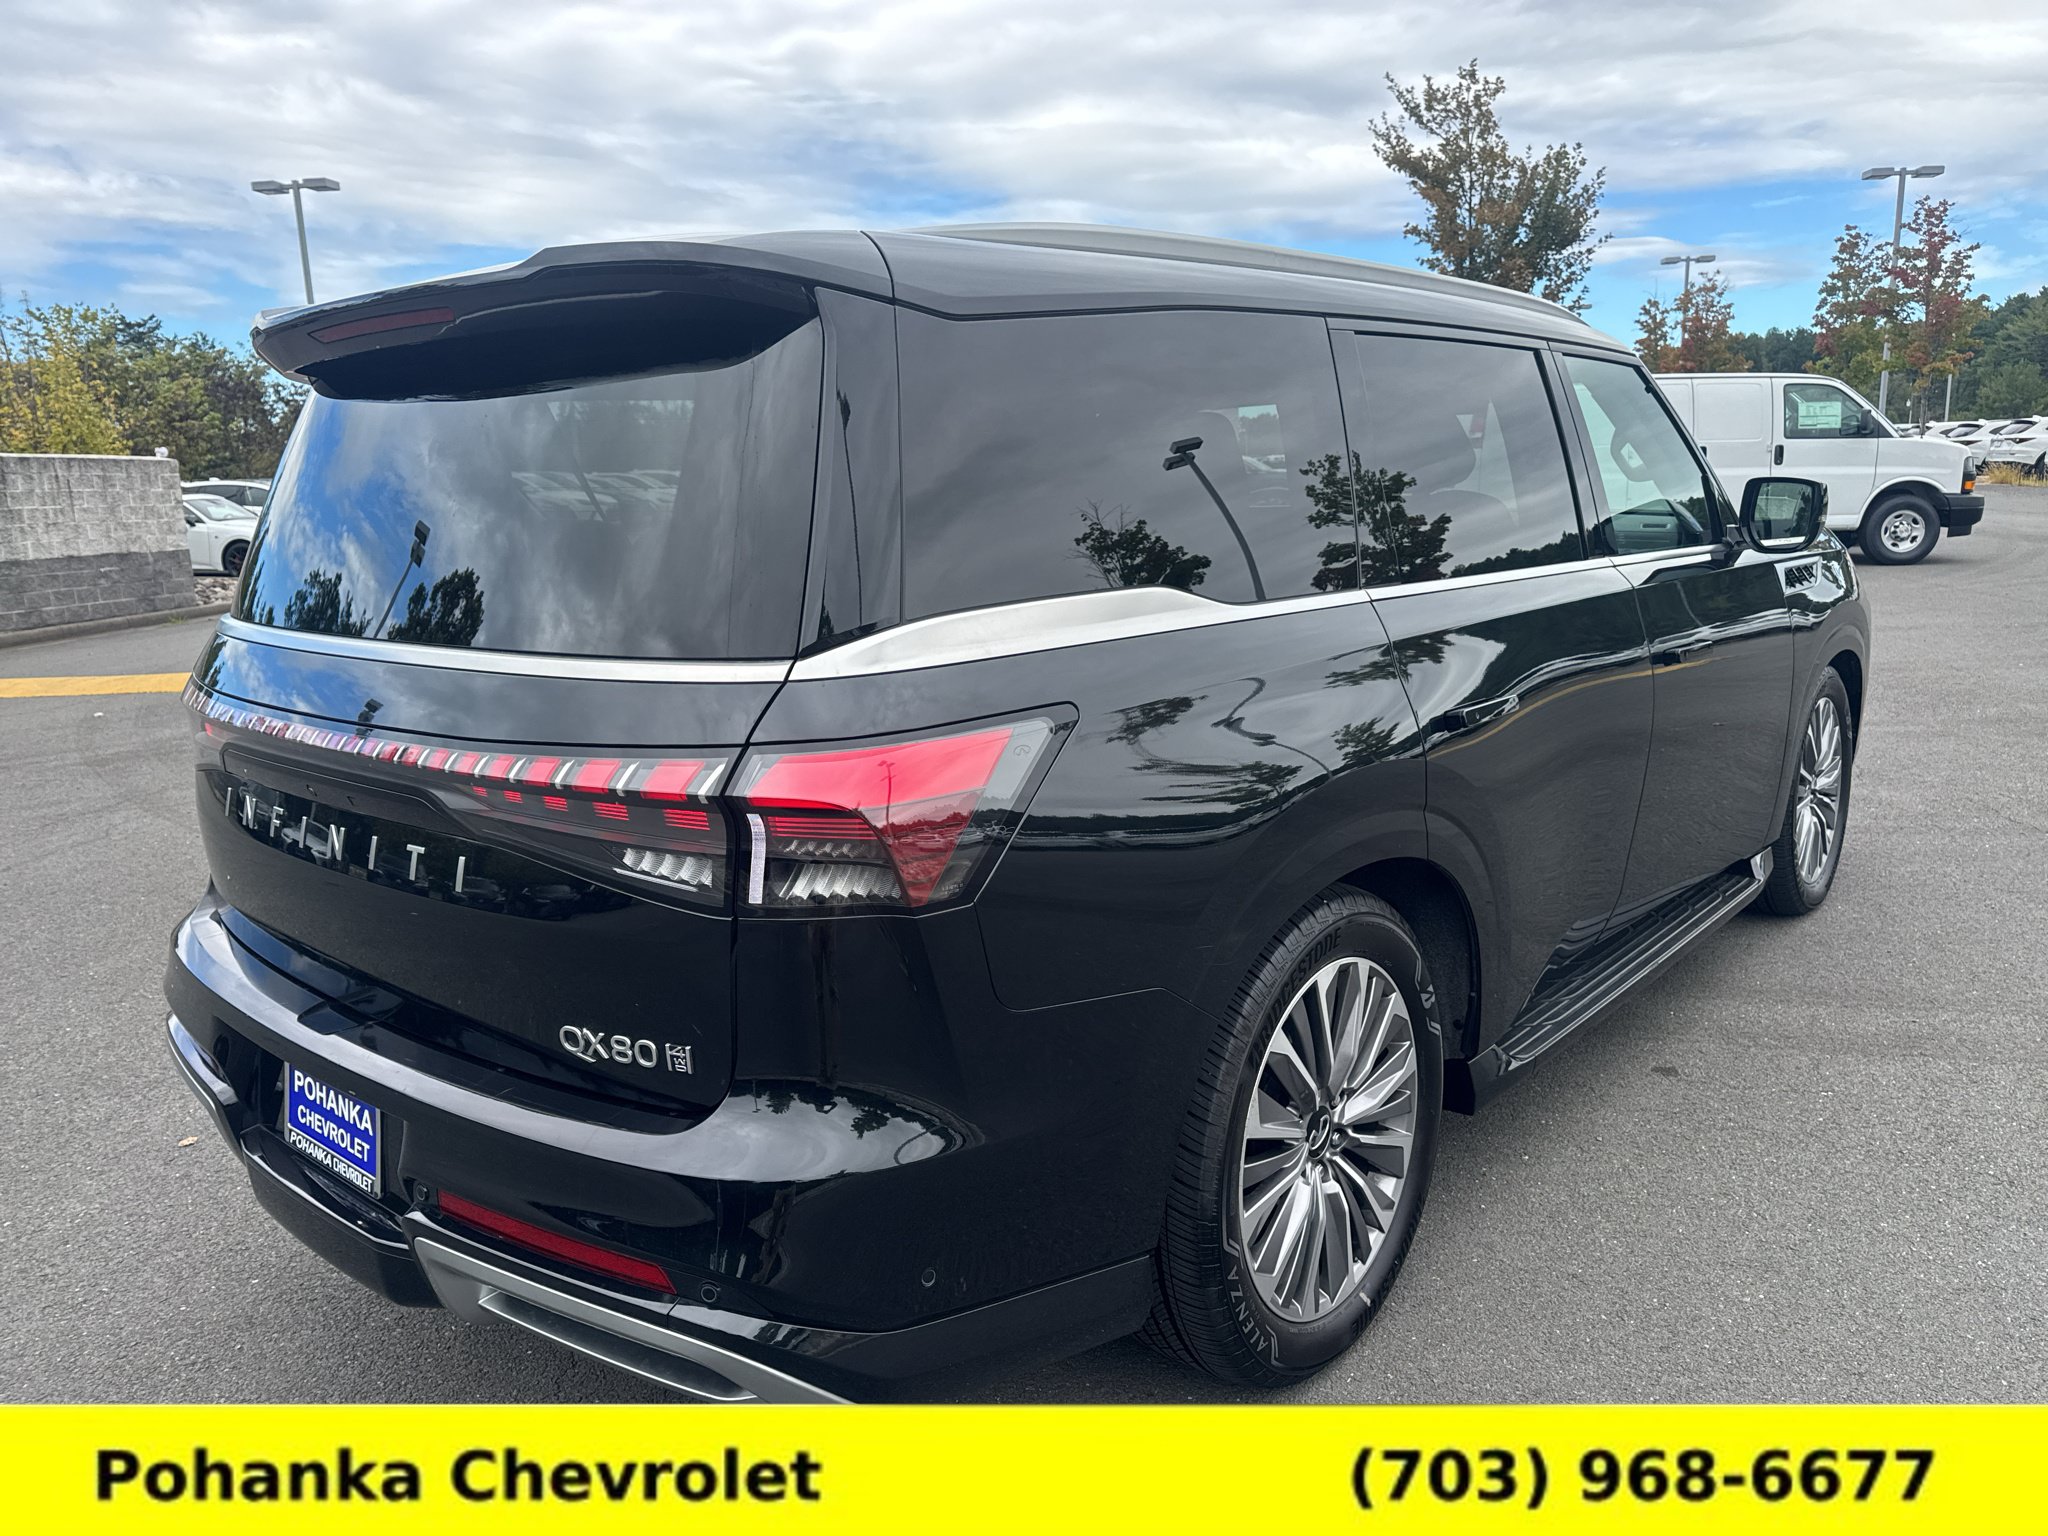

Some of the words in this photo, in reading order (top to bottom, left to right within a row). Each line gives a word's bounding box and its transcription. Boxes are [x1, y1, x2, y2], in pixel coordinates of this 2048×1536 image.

[225, 787, 466, 892] INFINITI
[559, 1025, 657, 1069] QX80
[294, 1069, 373, 1136] POHANKA
[297, 1104, 370, 1163] CHEVROLET
[289, 1131, 332, 1168] POHANKA
[332, 1157, 373, 1193] CHEVROLET
[1227, 1264, 1269, 1352] ALENZA
